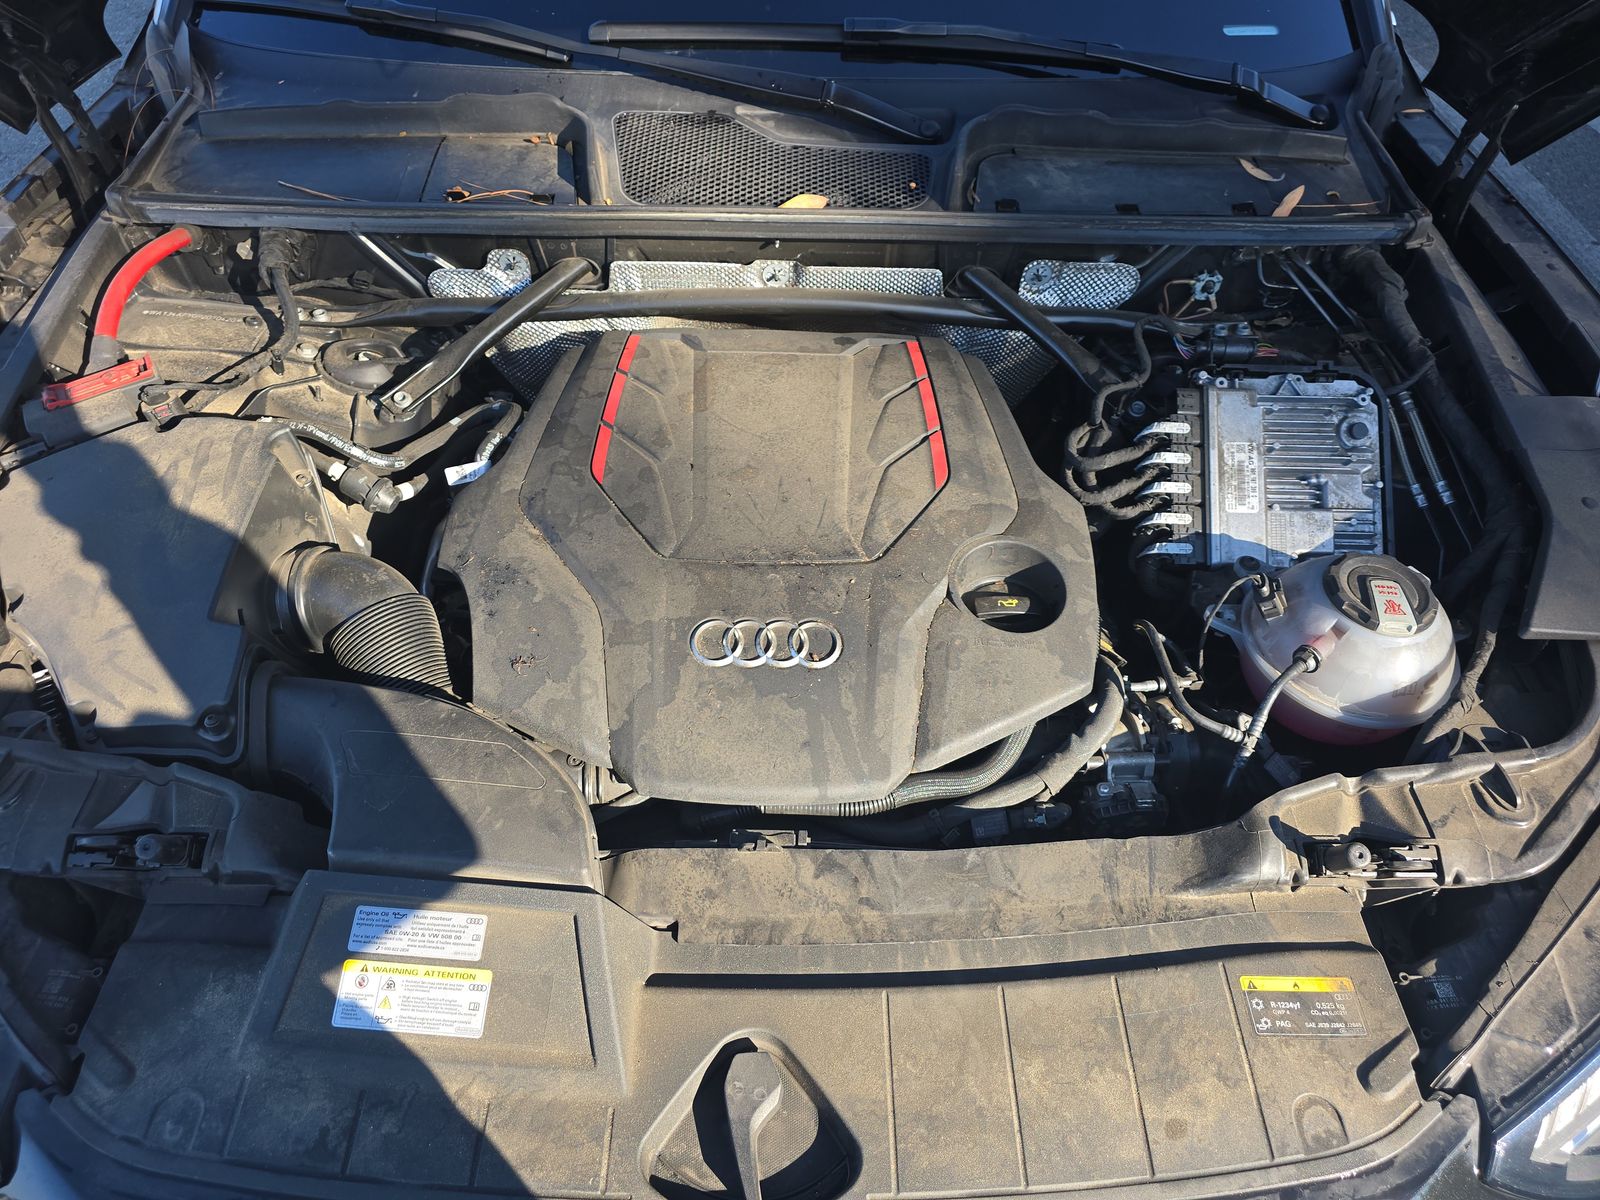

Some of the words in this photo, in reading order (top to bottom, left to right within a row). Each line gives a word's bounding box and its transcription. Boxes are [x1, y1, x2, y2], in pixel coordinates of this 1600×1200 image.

[372, 966, 418, 976] WARNING
[424, 970, 476, 980] ATTENTION
[1270, 1001, 1300, 1010] R-1234yf
[1336, 1002, 1344, 1010] kg
